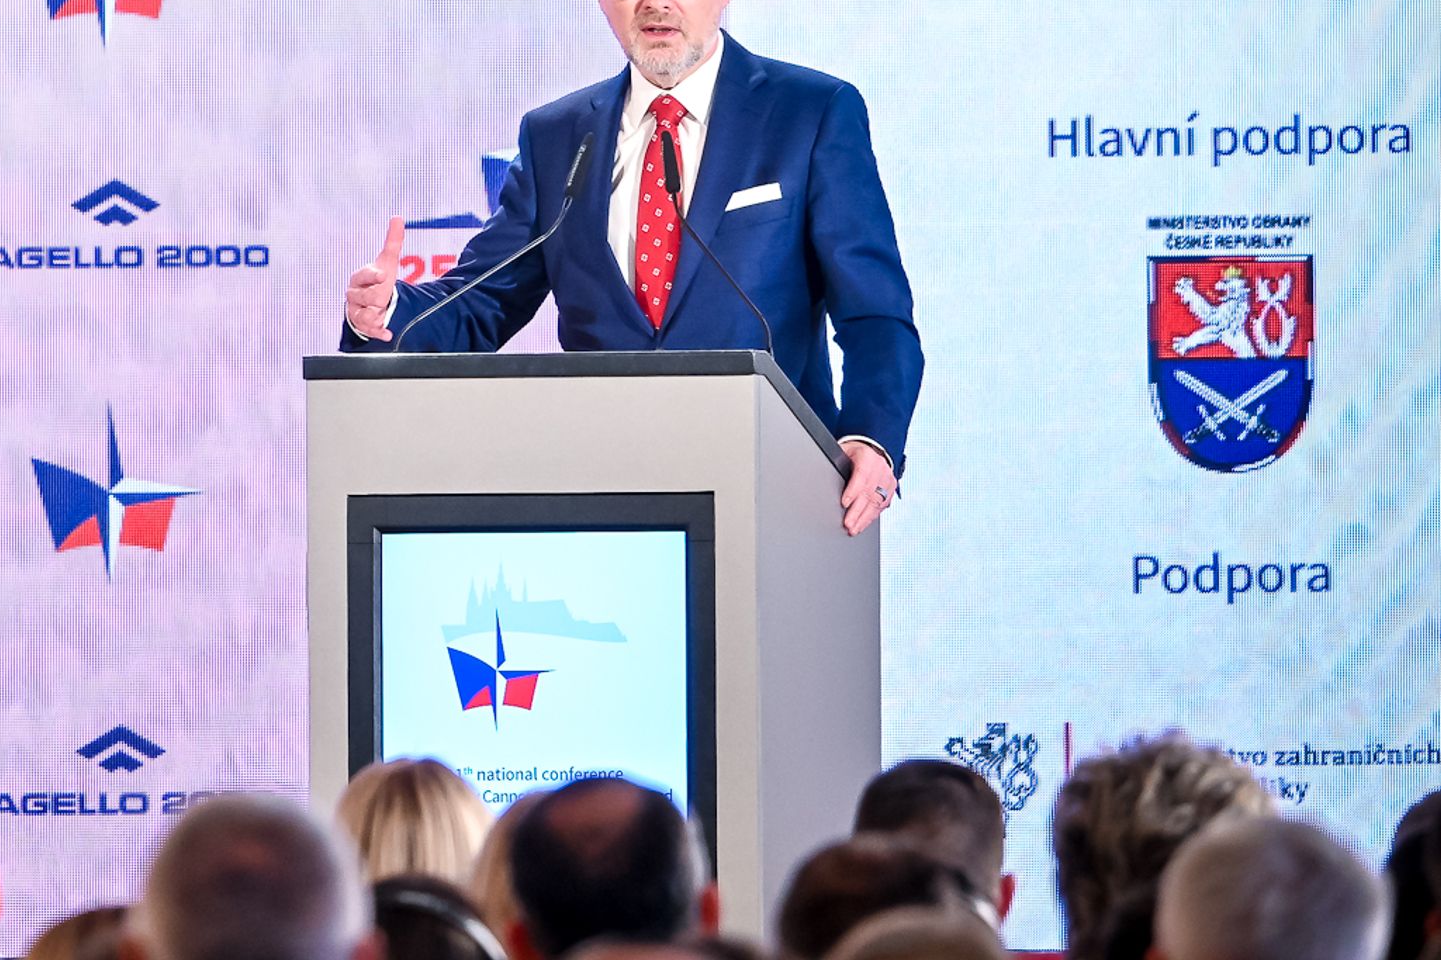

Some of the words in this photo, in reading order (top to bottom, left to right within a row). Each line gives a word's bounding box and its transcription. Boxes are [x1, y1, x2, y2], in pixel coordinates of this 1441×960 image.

[1048, 111, 1198, 157] Hlavní
[1212, 114, 1413, 166] podpora
[156, 245, 270, 269] 2000
[1132, 552, 1333, 605] Podpora
[477, 767, 537, 781] national
[482, 789, 525, 803] Cann
